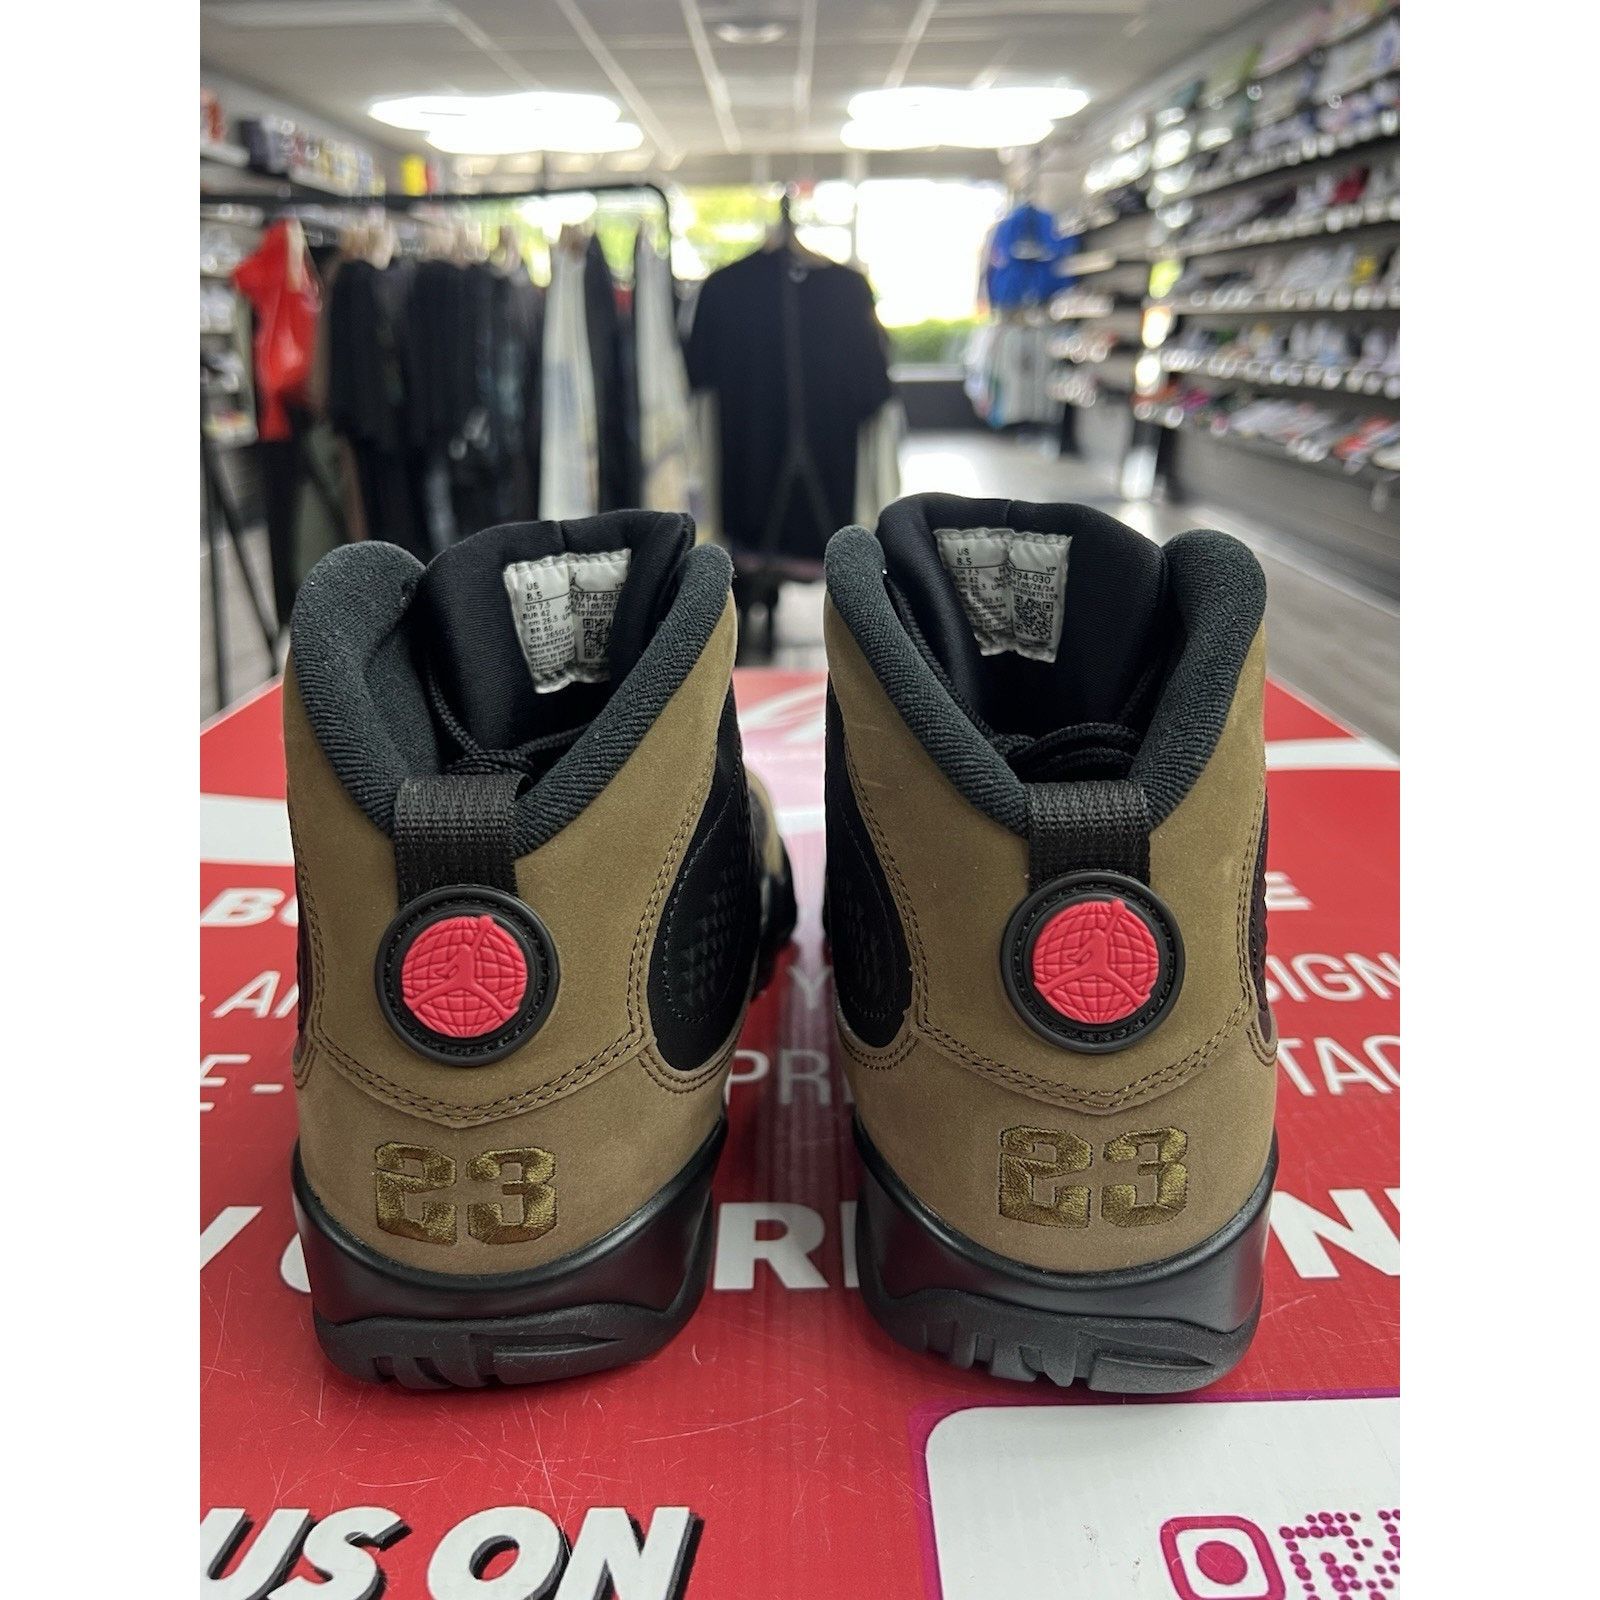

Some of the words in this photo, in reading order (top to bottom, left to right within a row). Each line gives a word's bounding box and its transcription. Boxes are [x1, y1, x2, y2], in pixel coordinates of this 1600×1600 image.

[957, 547, 970, 556] US
[957, 557, 973, 566] 8.5
[526, 582, 539, 591] US
[527, 591, 543, 601] 8.5
[998, 1125, 1189, 1228] 23
[374, 1141, 558, 1246] 23
[427, 1506, 704, 1600] ON
